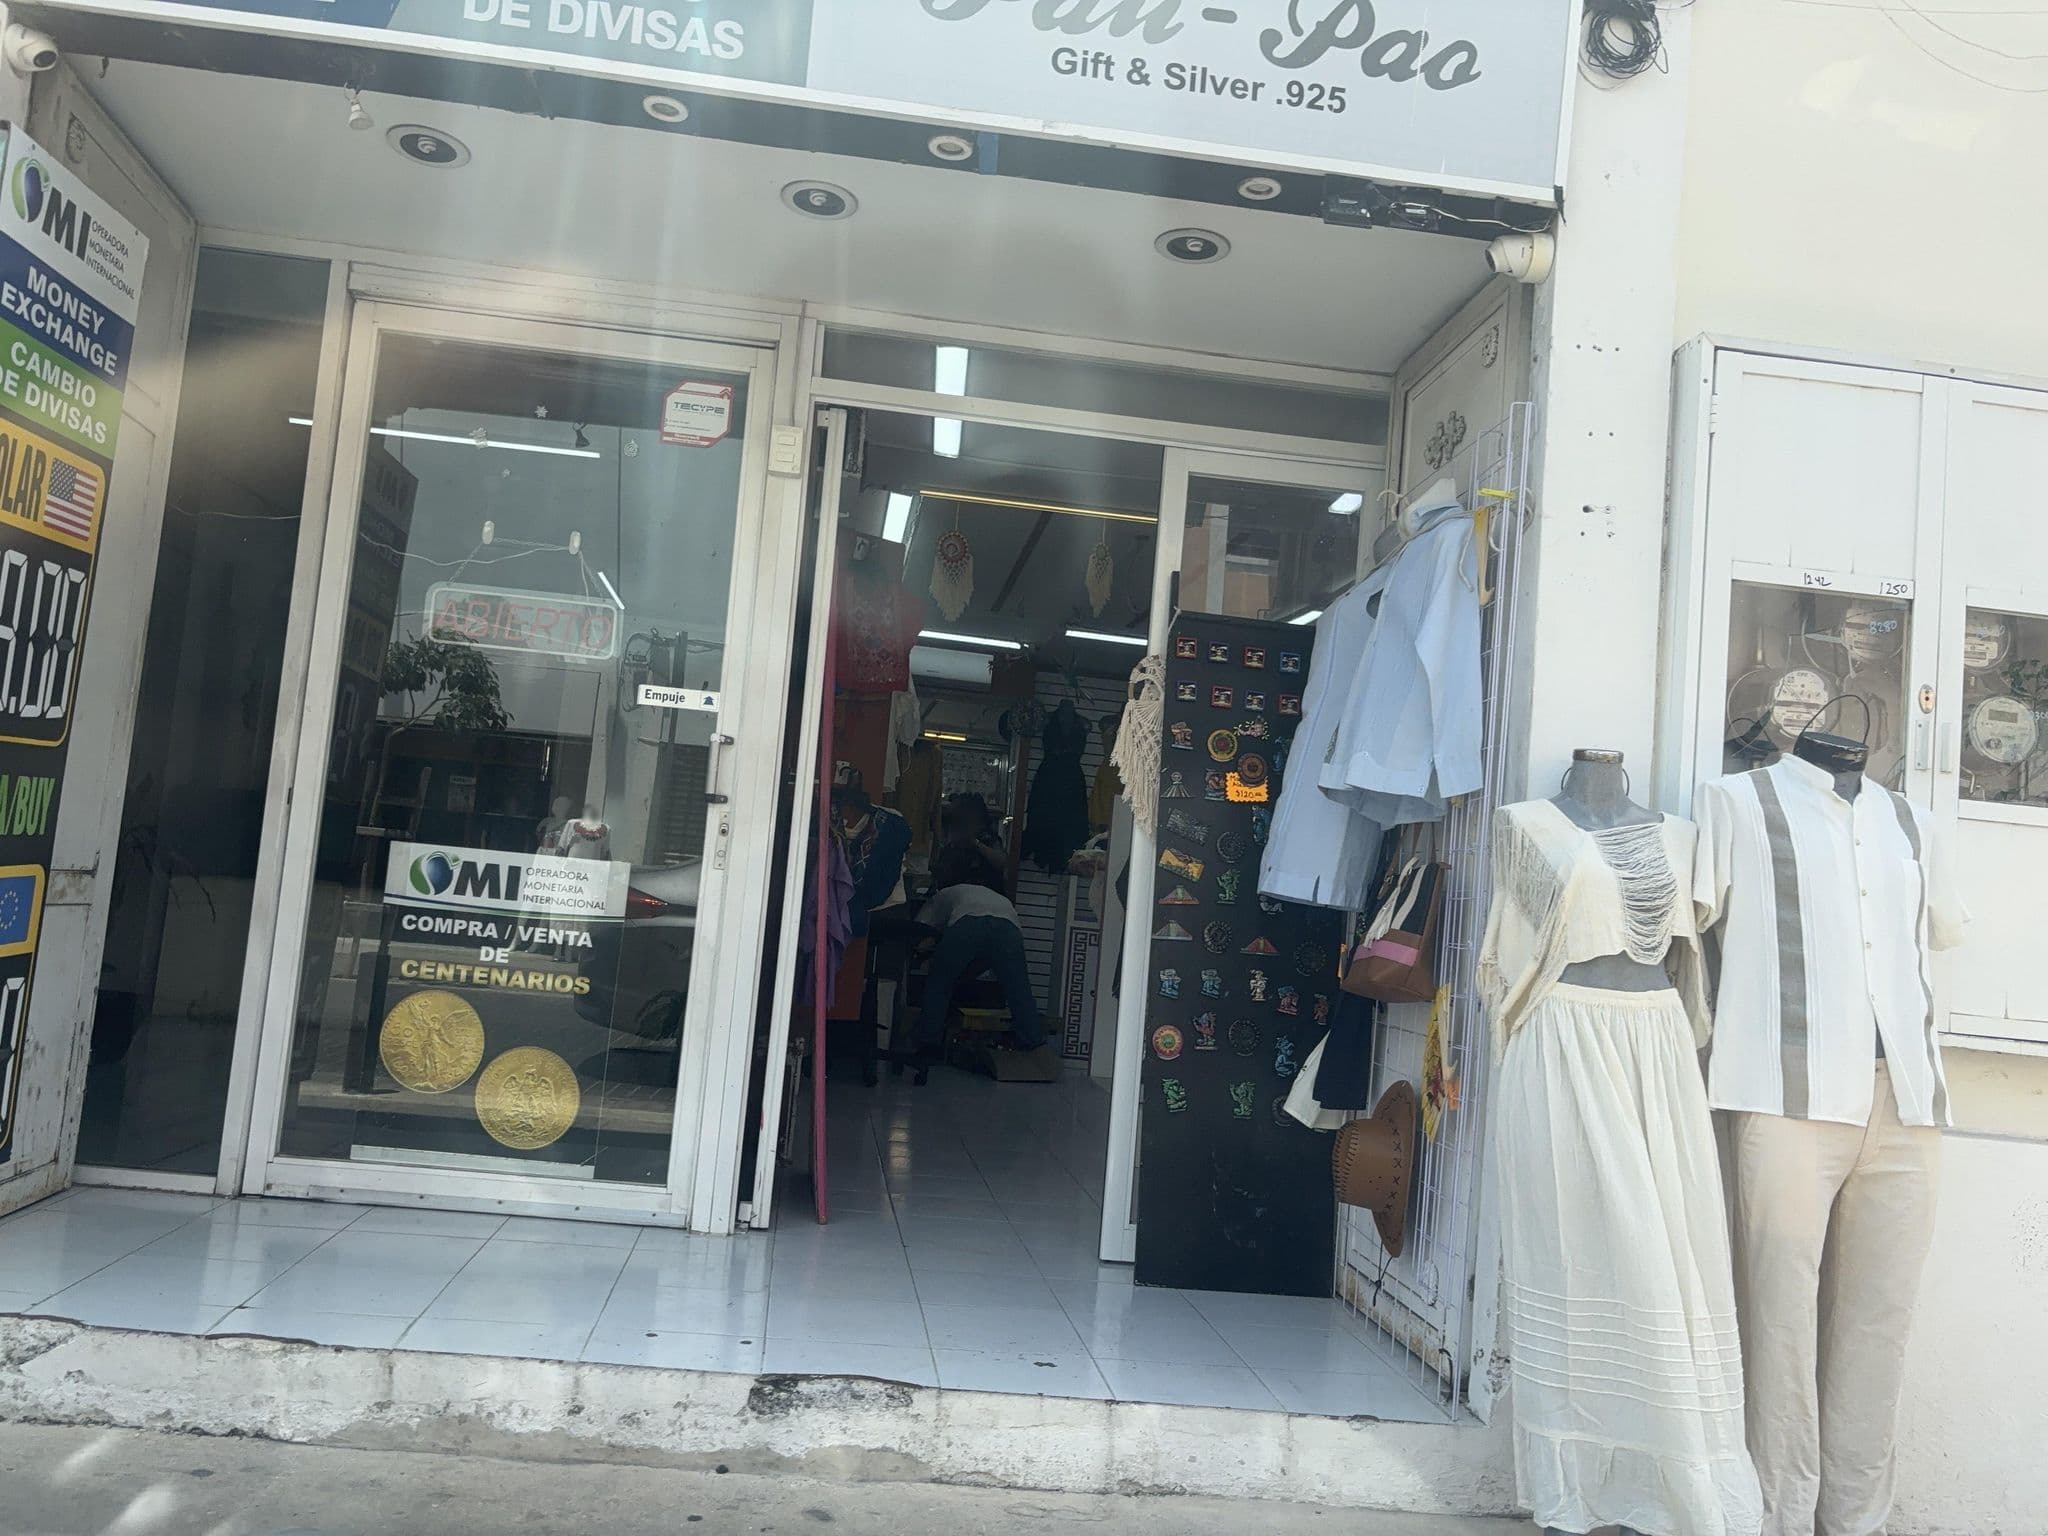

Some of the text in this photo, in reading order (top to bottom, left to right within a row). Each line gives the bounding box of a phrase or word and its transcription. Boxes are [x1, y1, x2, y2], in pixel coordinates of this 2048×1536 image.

[464, 0, 744, 60] DE DIVISAS
[1051, 47, 1347, 114] Gift & Silver .925
[89, 238, 125, 273] MONETARIA
[91, 220, 129, 258] OPERADORA
[85, 255, 135, 300] INTERNACIONAL
[27, 265, 105, 335] MONEY
[1, 281, 118, 377] EXCHANGE
[11, 341, 96, 408] CAMBIO
[25, 381, 107, 445] DIVISAS
[674, 401, 725, 415] TECYPE
[1803, 572, 1832, 588] 1242
[1879, 581, 1909, 596] 1250
[435, 598, 612, 650] ABIERTO
[645, 688, 686, 704] Empuje
[523, 881, 584, 896] MONETARIA
[526, 866, 589, 882] OPERADORA
[522, 893, 606, 911] INTERNACIONAL
[402, 914, 499, 940] COMPRA
[518, 925, 593, 949] VENTA
[479, 946, 510, 965] DE
[401, 959, 591, 996] CENTENARIOS
